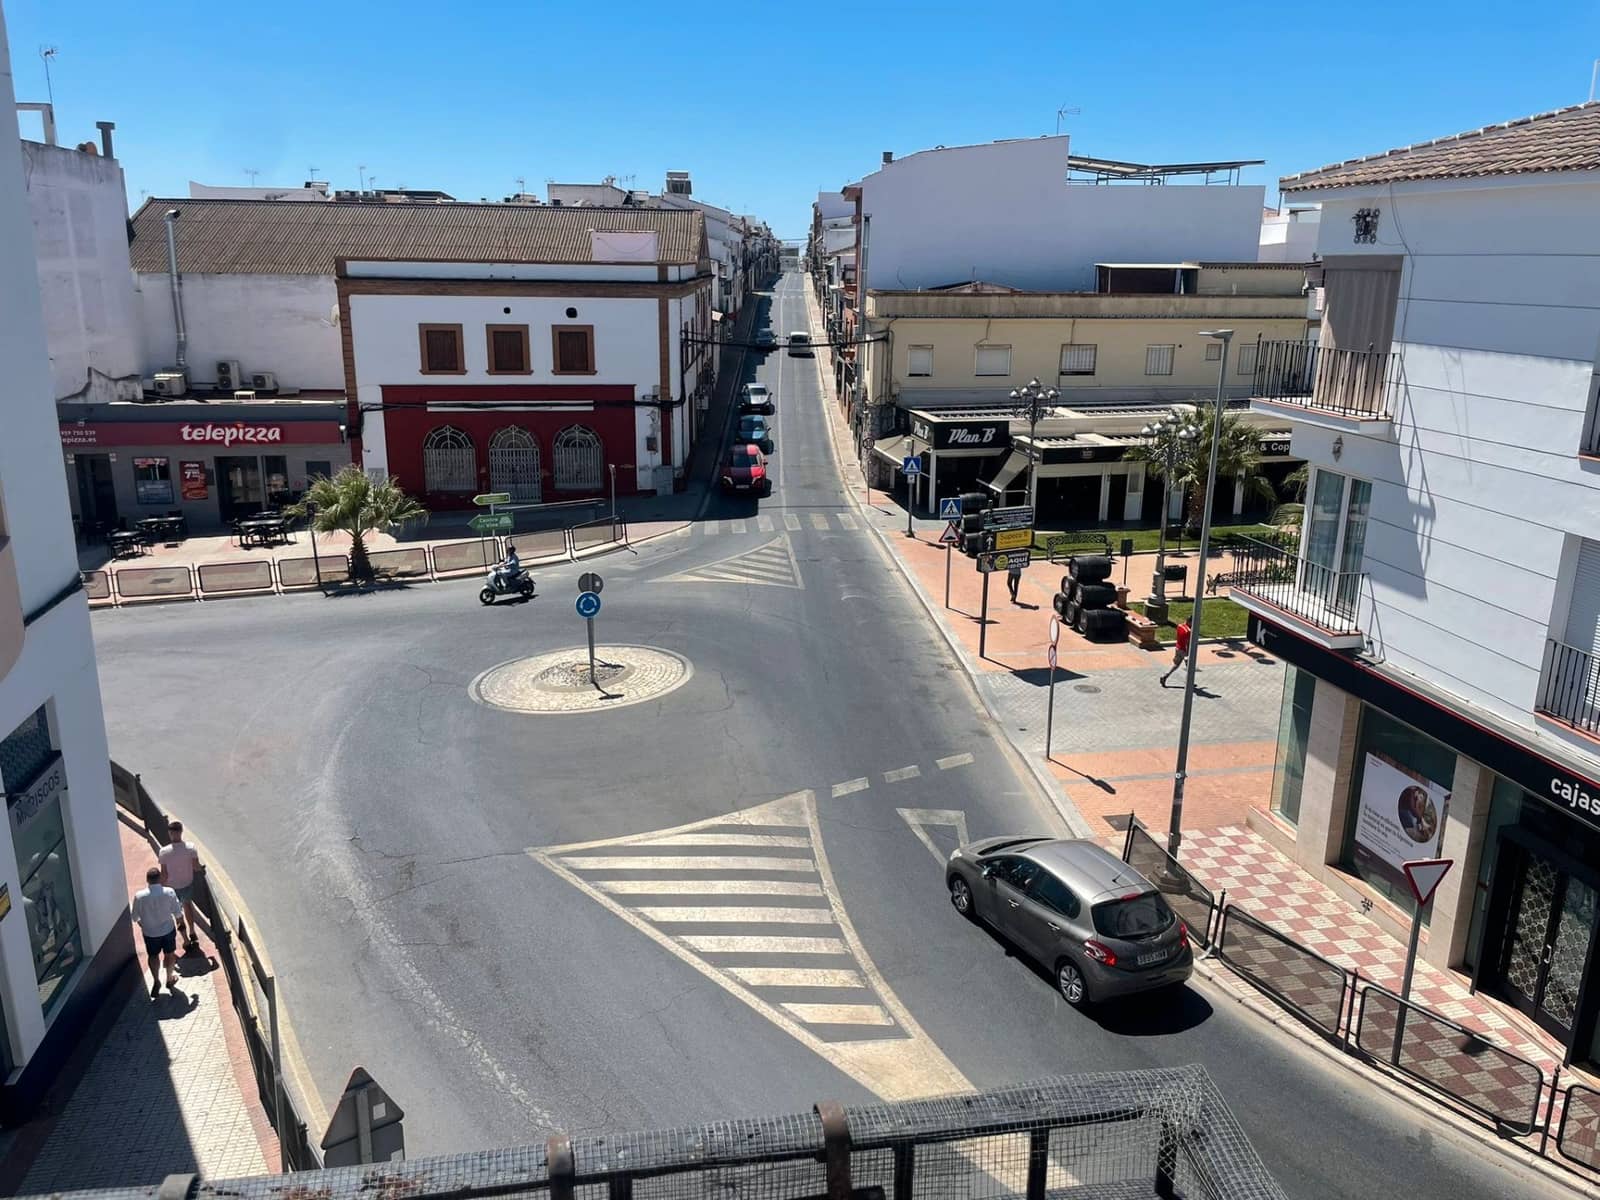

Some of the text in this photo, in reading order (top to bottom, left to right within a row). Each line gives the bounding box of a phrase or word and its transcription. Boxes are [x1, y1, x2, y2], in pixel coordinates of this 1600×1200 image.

[181, 423, 281, 447] telepizza
[947, 427, 996, 444] Plan B
[1260, 442, 1267, 451] &
[1551, 778, 1600, 816] cajas
